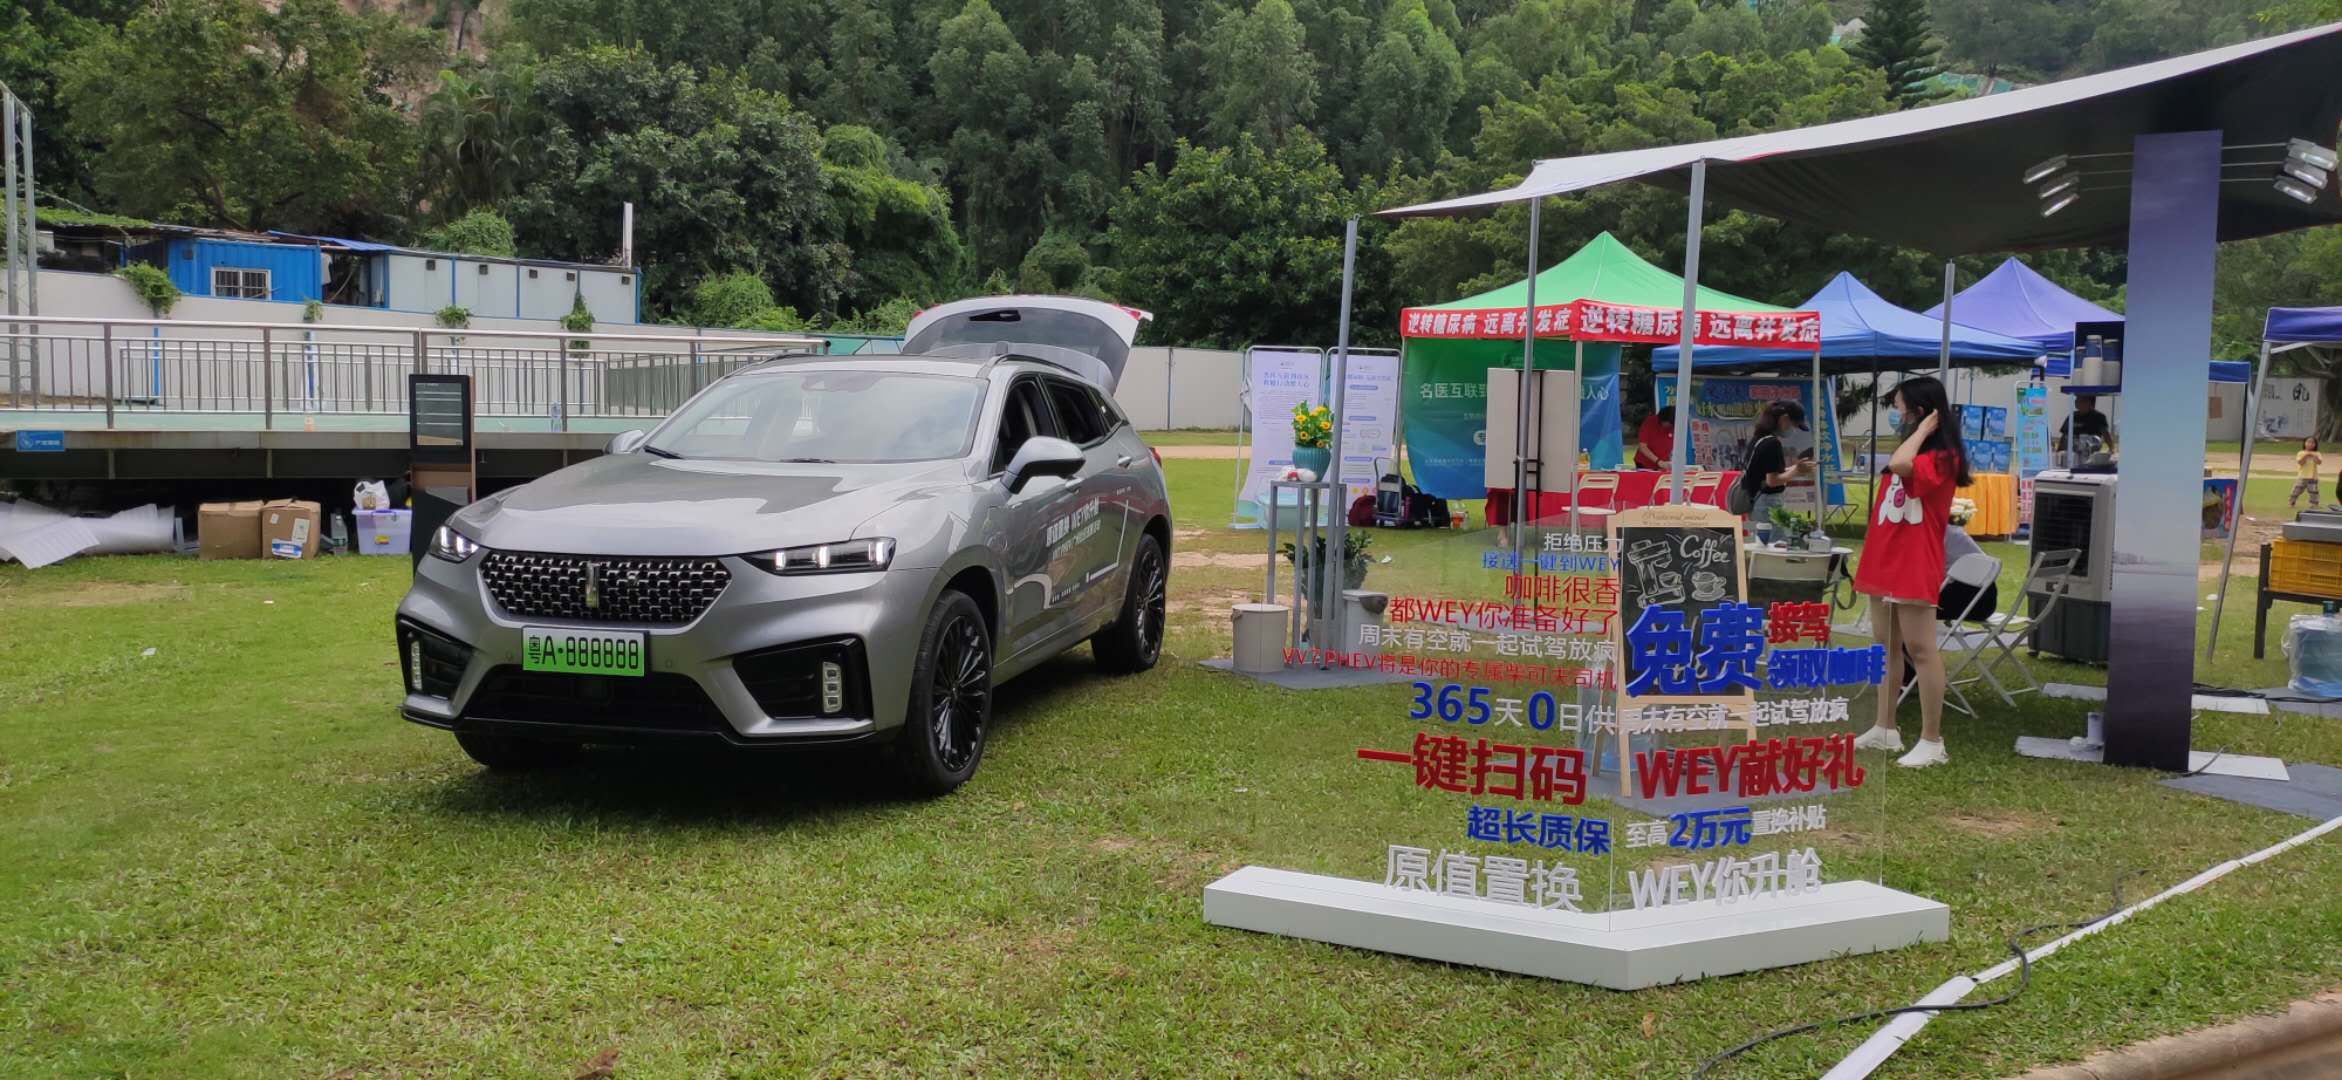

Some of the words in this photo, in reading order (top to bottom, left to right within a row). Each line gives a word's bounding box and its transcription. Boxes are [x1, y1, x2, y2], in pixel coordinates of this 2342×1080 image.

[1407, 313, 1477, 334] 逆转糖尿病
[1708, 313, 1820, 343] 远离并发症
[1680, 535, 1731, 568] Coffee
[1505, 575, 1620, 606] 咖啡很香
[1390, 597, 1618, 635] 都WEY你准备好了
[1768, 600, 1830, 644] 接驾
[1359, 624, 1615, 662] 周末有空就一起试驾放疯
[1626, 603, 1764, 698] 免费
[1767, 644, 1887, 689] 领取咖啡
[1410, 682, 1616, 736] 365天0日供
[1357, 732, 1587, 805] 一键扫码
[1635, 733, 1866, 800] WEY献好礼
[1466, 804, 1612, 856] 超长质保
[1625, 804, 1826, 850] 至高2万元置换补贴
[1384, 844, 1583, 913] 原值置换
[1628, 848, 1823, 911] WEY你升舱
